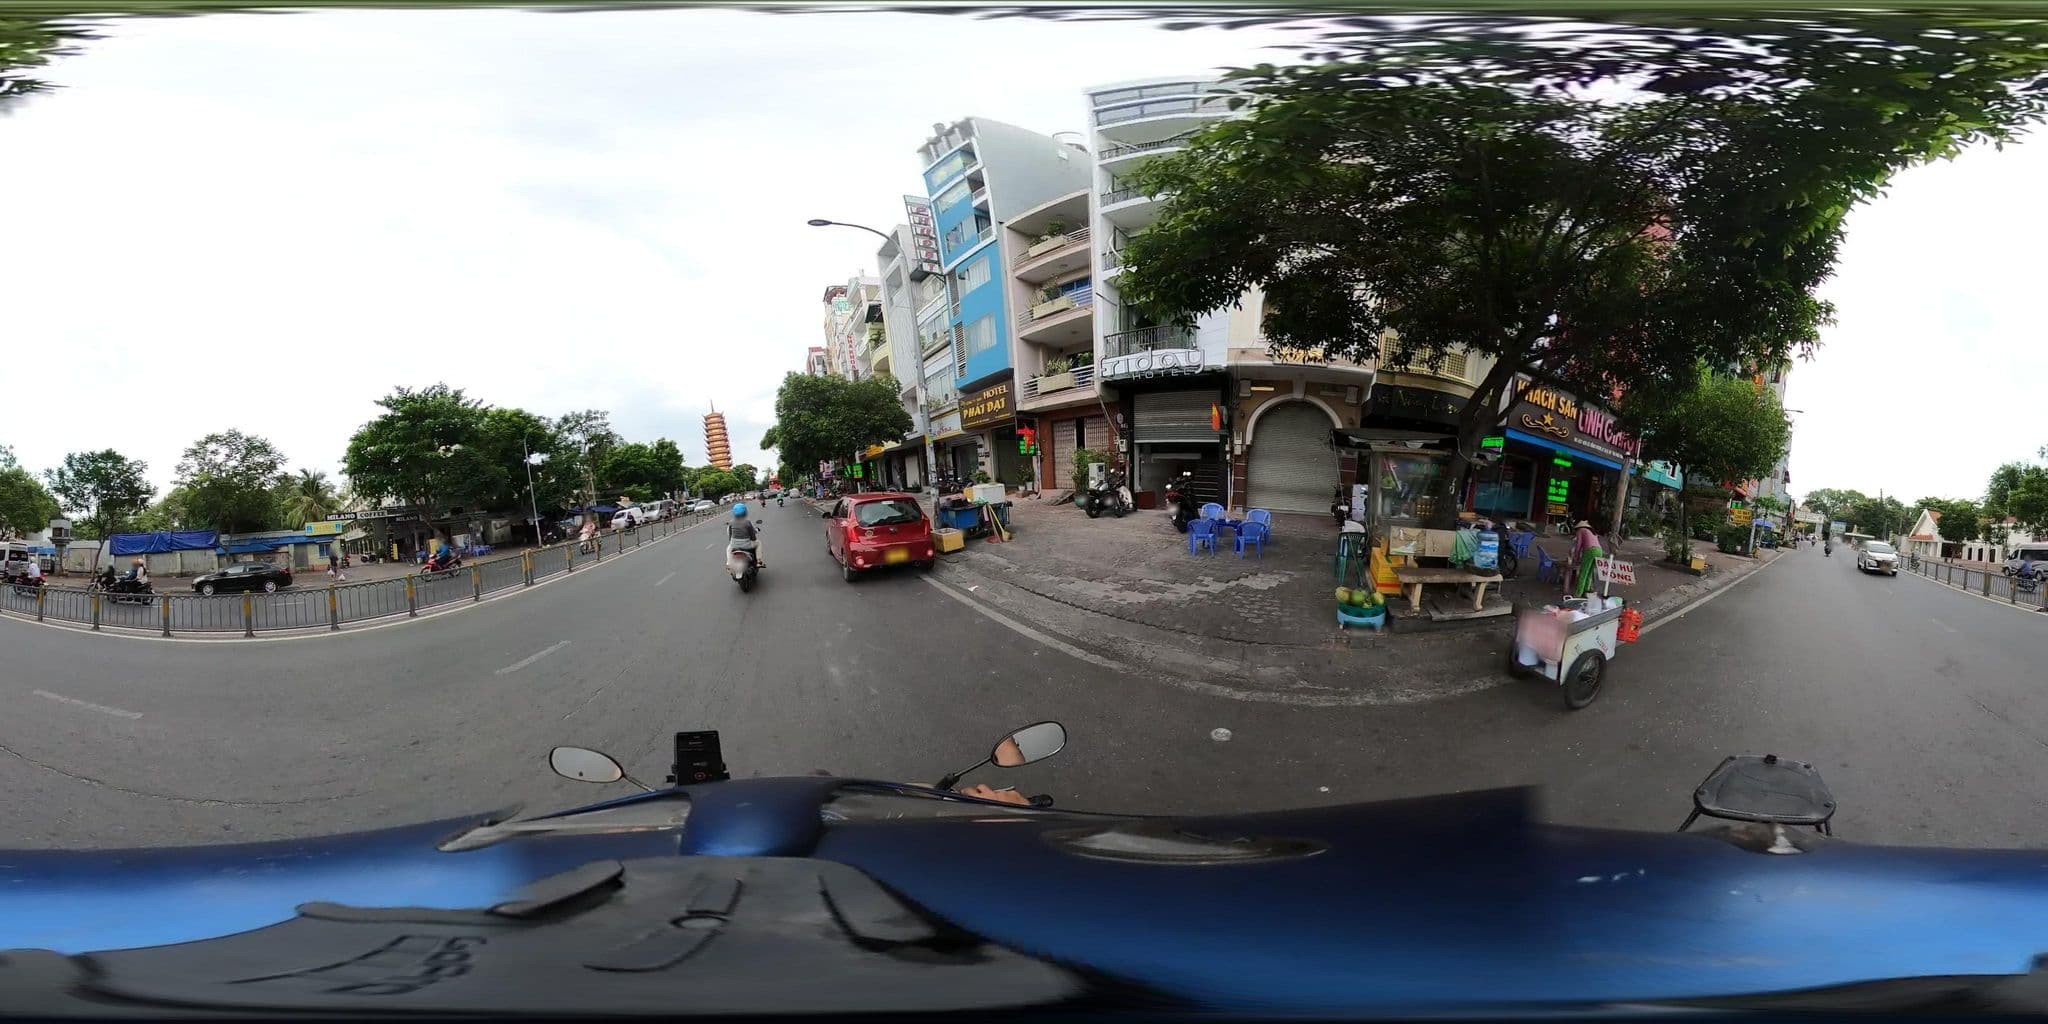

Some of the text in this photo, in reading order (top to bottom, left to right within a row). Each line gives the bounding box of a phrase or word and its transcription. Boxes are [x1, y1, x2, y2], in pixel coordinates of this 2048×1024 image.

[1132, 369, 1192, 380] HOTEL
[983, 384, 1009, 400] HOTEL
[327, 513, 356, 521] MILANO
